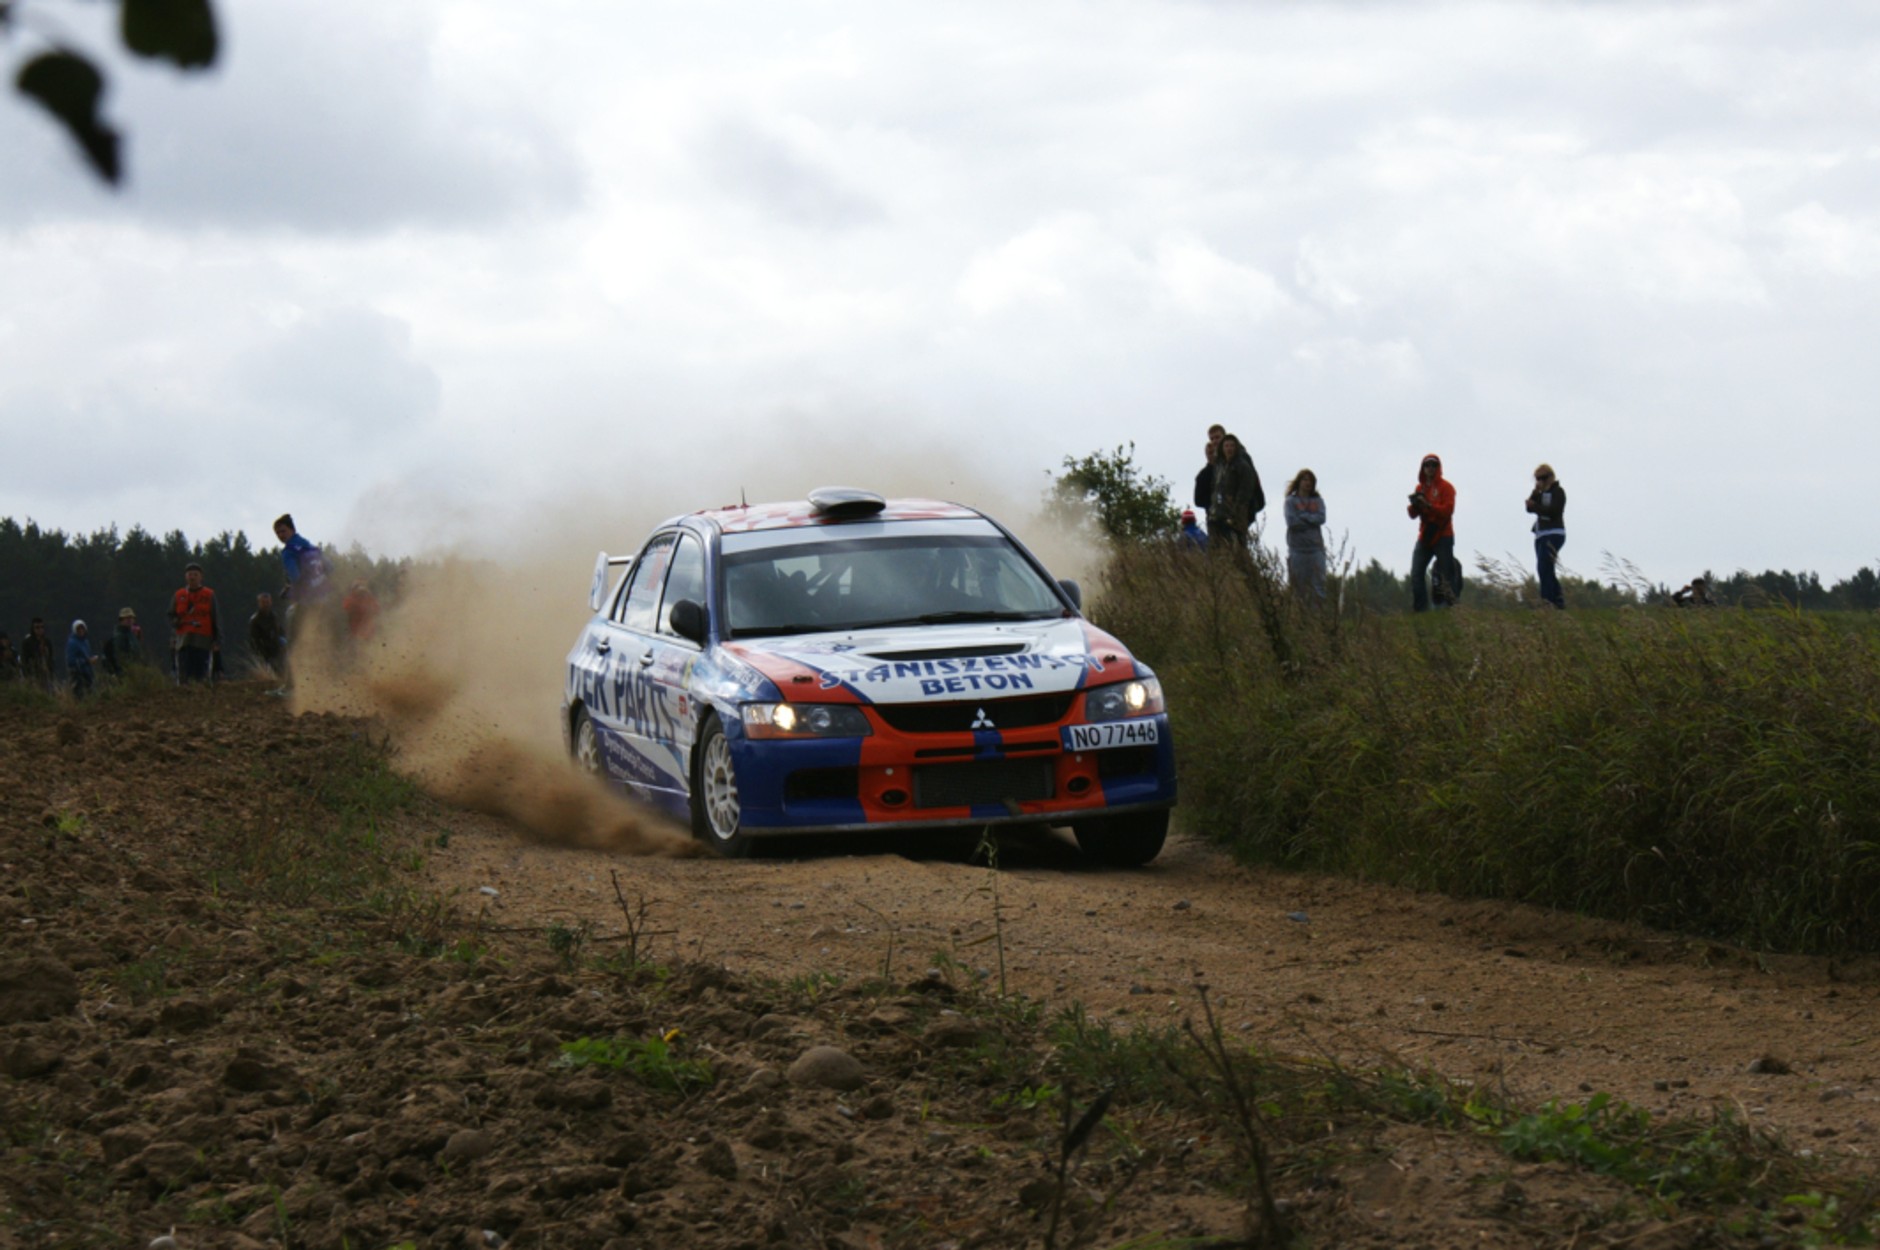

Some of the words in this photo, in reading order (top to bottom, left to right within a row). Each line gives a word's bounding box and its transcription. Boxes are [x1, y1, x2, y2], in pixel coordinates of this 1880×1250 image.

[921, 673, 1033, 696] BETON
[614, 667, 681, 743] PARTS
[1074, 727, 1100, 748] NO
[1103, 721, 1156, 745] 77446
